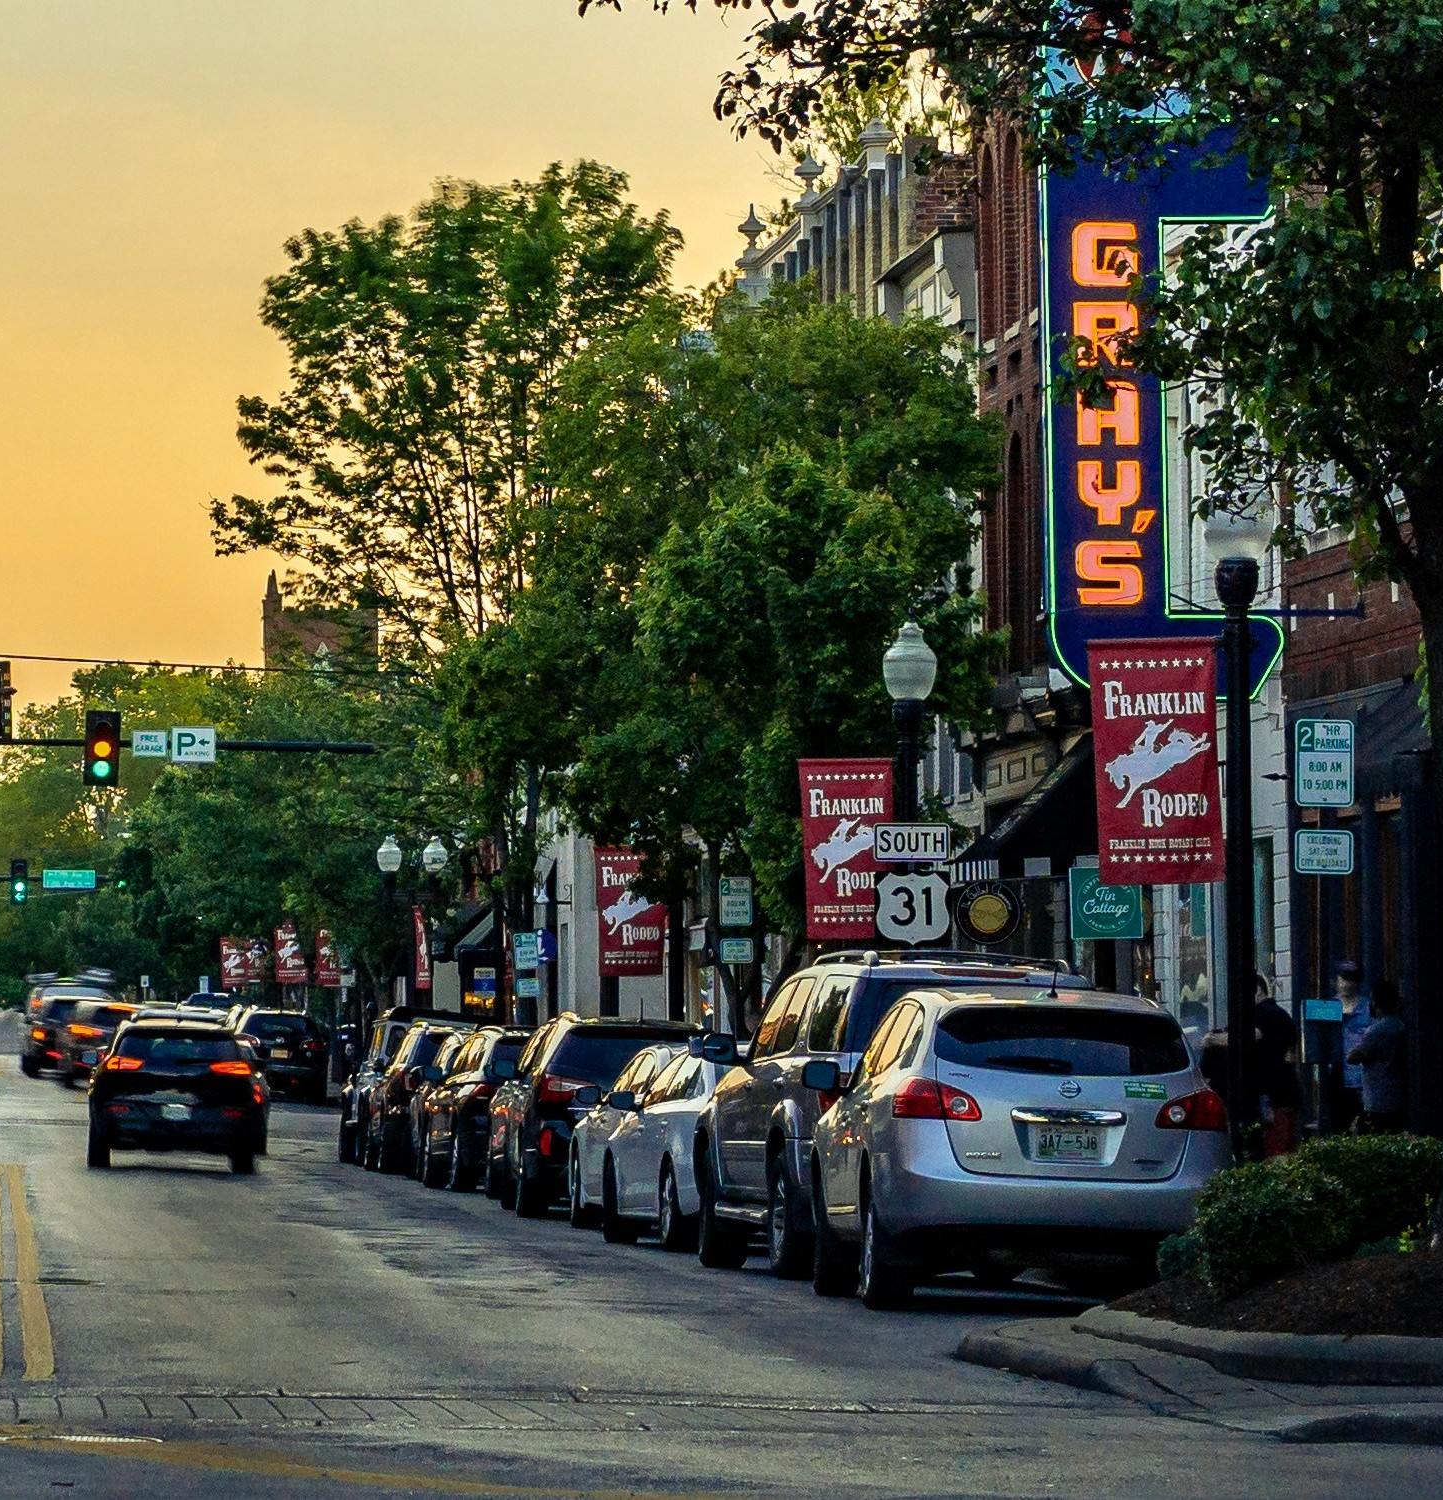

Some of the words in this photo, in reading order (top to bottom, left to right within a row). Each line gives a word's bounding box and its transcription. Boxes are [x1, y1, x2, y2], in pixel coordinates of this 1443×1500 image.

[1071, 221, 1156, 606] GRAY'S
[1101, 680, 1206, 720] FRANKLIN
[140, 734, 158, 742] FREE
[1300, 726, 1312, 747] 2
[1326, 725, 1341, 736] HR
[135, 744, 163, 753] GARAGE
[1315, 738, 1350, 749] PARKING
[1330, 761, 1342, 772] AM
[809, 788, 885, 818] FRANKLIN
[1141, 788, 1209, 828] RODEO
[879, 830, 945, 852] SOUTH
[721, 883, 729, 894] 2
[836, 868, 876, 897] ROD
[1095, 886, 1116, 901] Tin
[889, 886, 933, 926] 31
[1082, 898, 1130, 918] Cottage
[622, 923, 659, 946] RODEO
